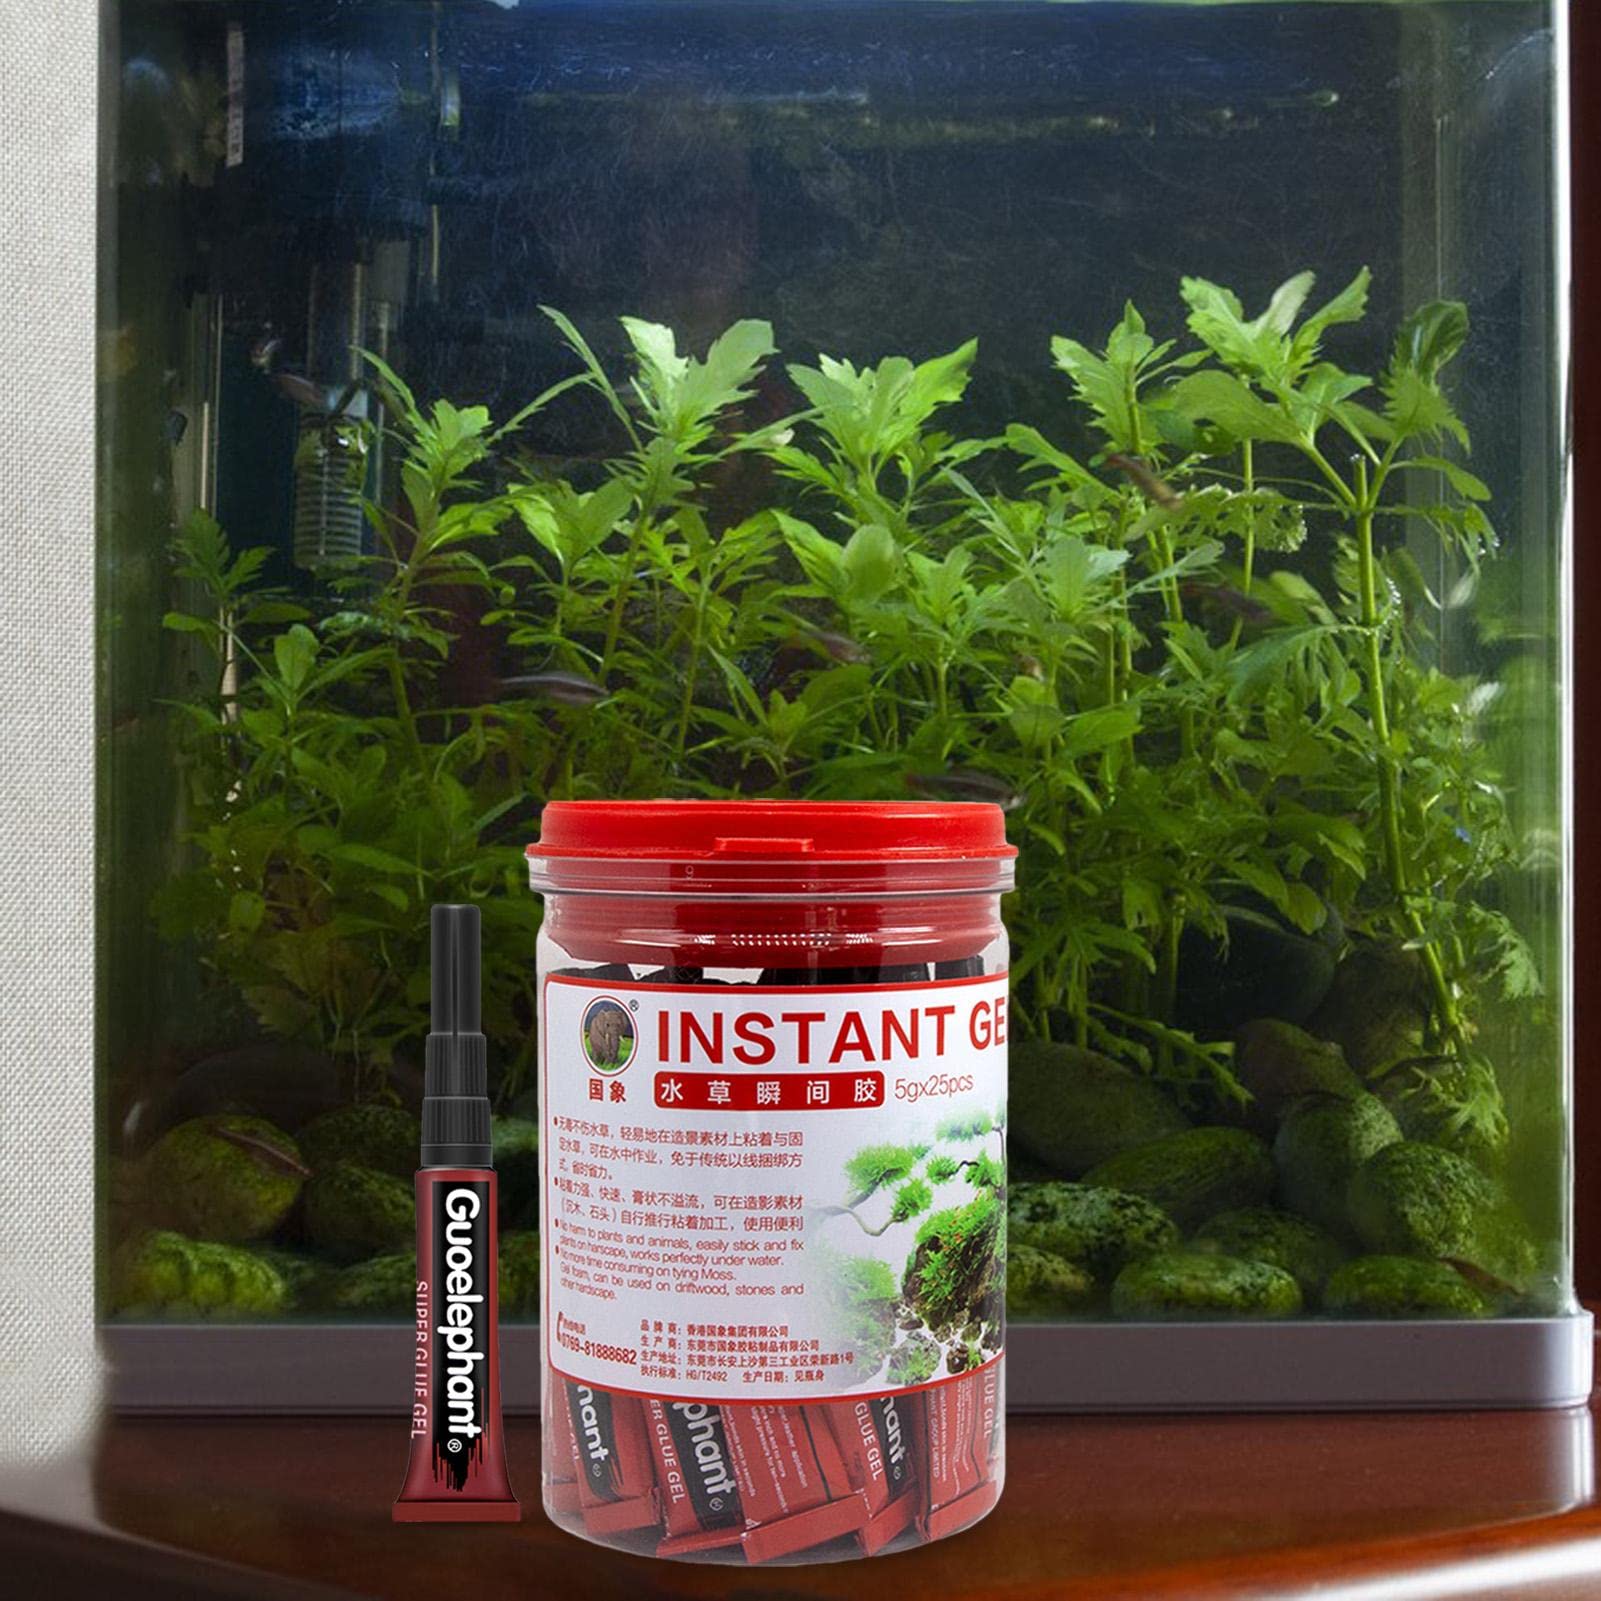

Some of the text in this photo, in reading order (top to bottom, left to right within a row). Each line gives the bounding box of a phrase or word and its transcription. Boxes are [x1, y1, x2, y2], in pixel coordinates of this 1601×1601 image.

[658, 1005, 955, 1066] INSTANT
[588, 1078, 627, 1103] 国象
[894, 1074, 974, 1103] 5gx25pcs
[587, 1227, 596, 1239] to
[598, 1229, 624, 1243] plants
[626, 1234, 645, 1246] and
[648, 1236, 692, 1251] animals,
[696, 1240, 729, 1254] easily
[733, 1239, 760, 1252] stick
[764, 1240, 787, 1252] and
[791, 1239, 804, 1251] fix
[587, 1256, 602, 1268] time
[604, 1260, 654, 1278] consuming
[656, 1266, 670, 1277] on
[673, 1266, 699, 1281] tying
[702, 1268, 737, 1281] Moss.
[630, 1250, 660, 1263] works
[662, 1252, 708, 1267] perfectly
[712, 1254, 745, 1266] under
[748, 1256, 784, 1267] water.
[593, 1272, 609, 1284] can
[612, 1274, 624, 1287] be
[627, 1278, 652, 1290] used
[656, 1281, 670, 1292] on
[675, 1281, 729, 1297] driftwood,
[735, 1284, 776, 1296] stones
[781, 1283, 804, 1295] and
[437, 1188, 484, 1439] Guoelephant
[561, 1332, 637, 1365] 0769-81888682
[411, 1403, 428, 1440] GEL
[984, 1407, 995, 1439] GEL
[854, 1401, 885, 1481] GLUE GEL
[655, 1423, 677, 1468] GLUE
[667, 1472, 686, 1504] GEL
